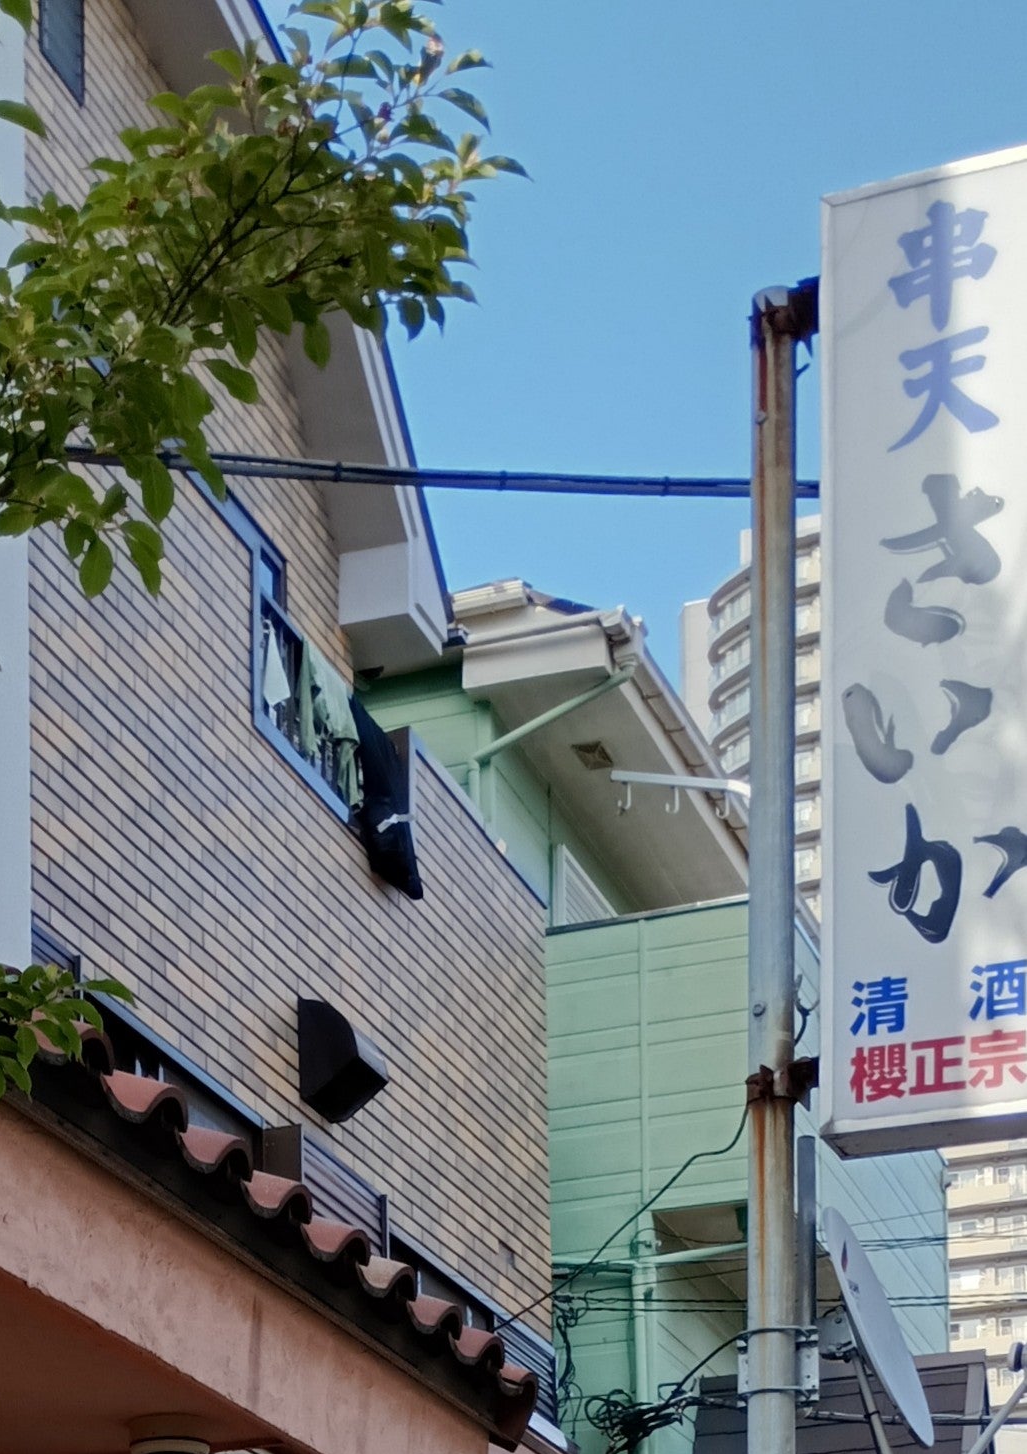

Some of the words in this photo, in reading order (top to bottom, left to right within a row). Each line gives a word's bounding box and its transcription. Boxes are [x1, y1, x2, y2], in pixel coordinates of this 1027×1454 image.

[850, 960, 1027, 1036] 清酒
[849, 1030, 1027, 1104] 櫻正宗
